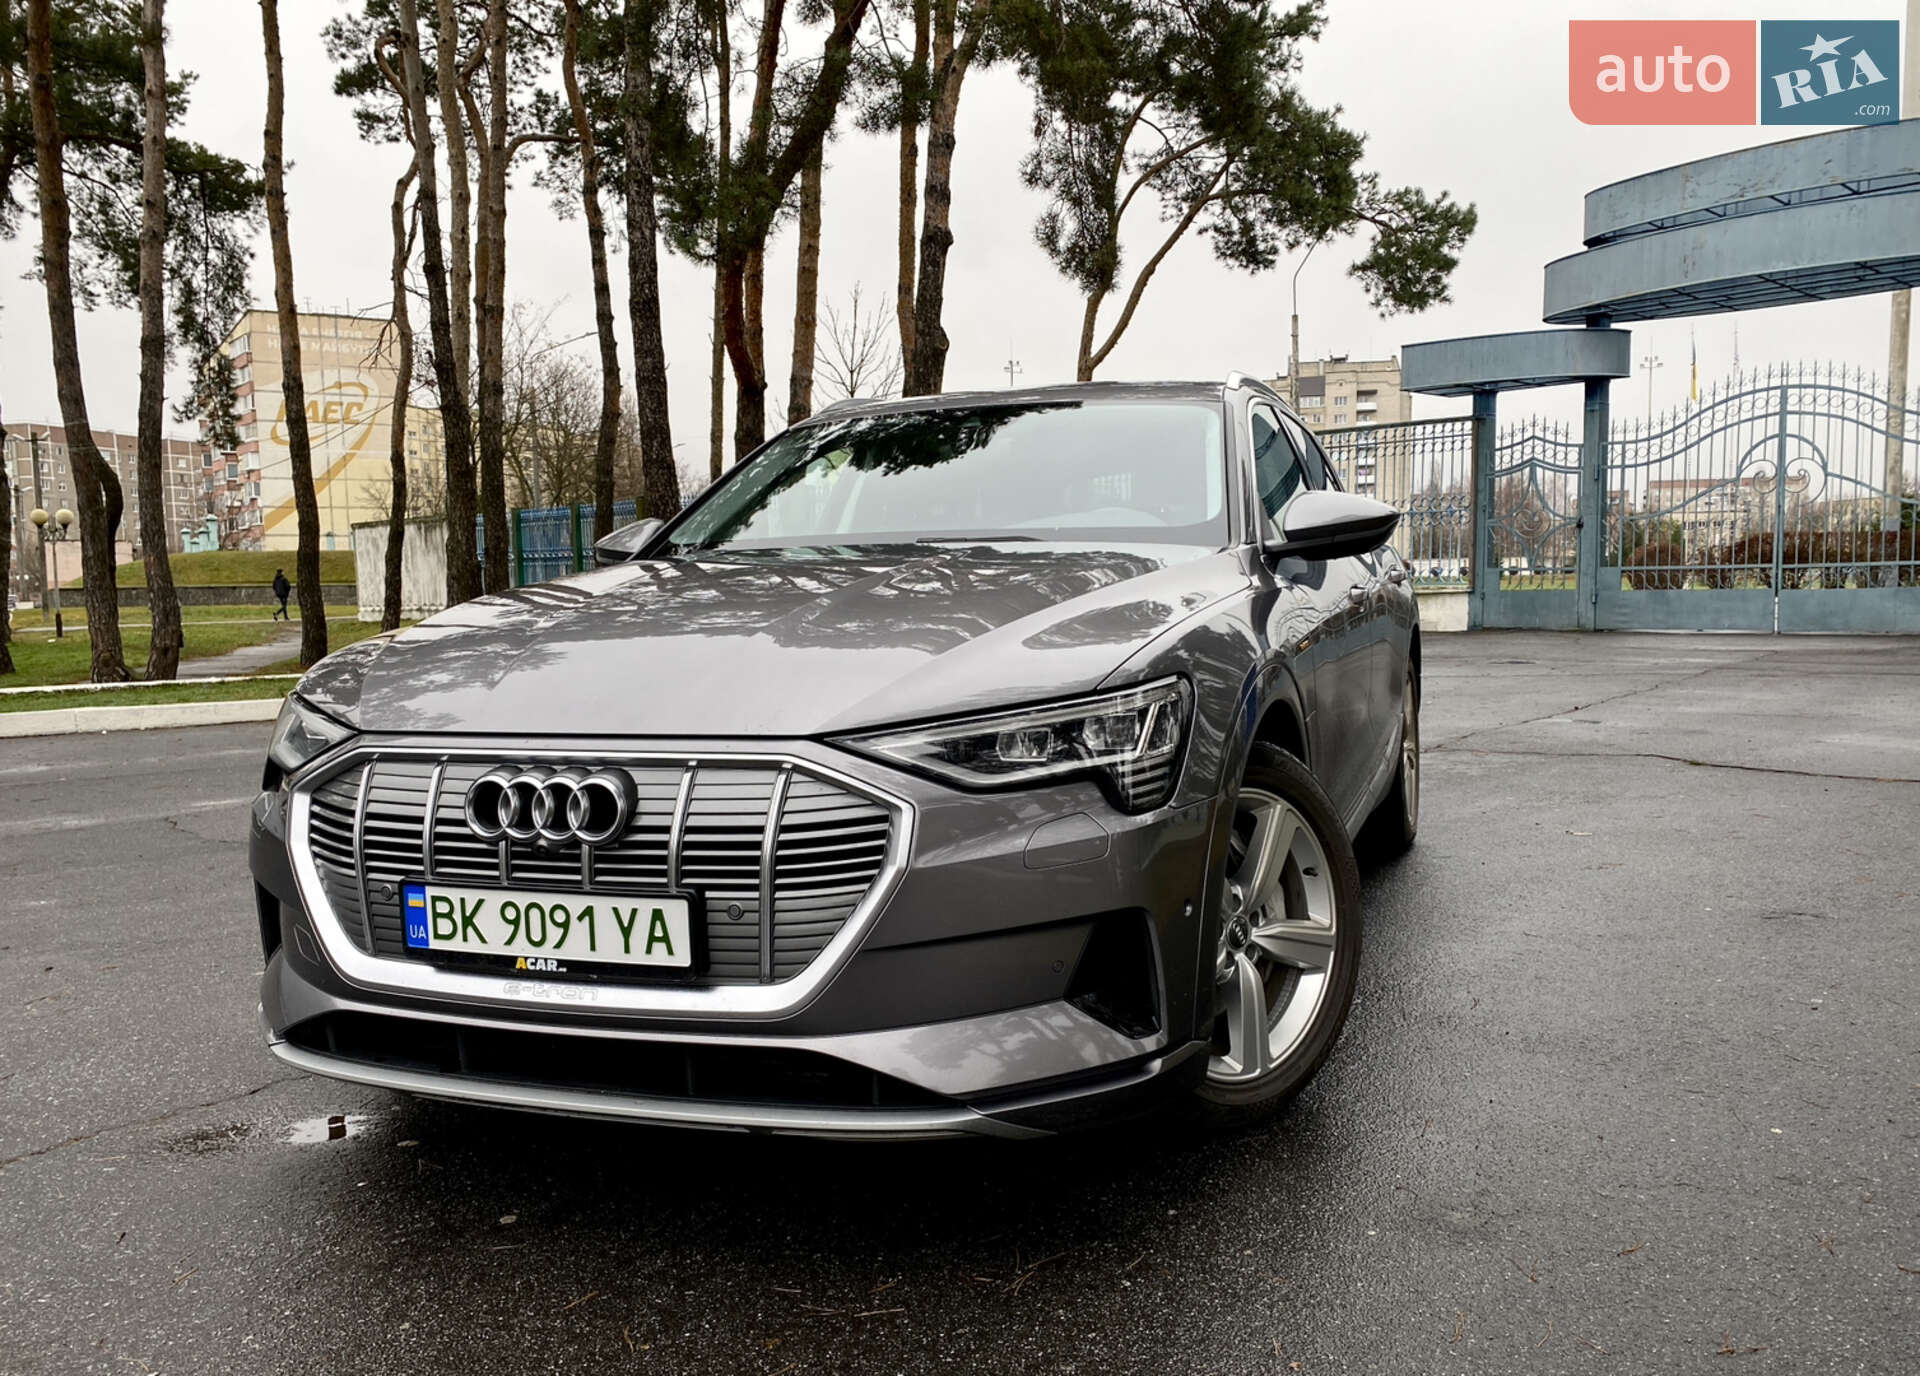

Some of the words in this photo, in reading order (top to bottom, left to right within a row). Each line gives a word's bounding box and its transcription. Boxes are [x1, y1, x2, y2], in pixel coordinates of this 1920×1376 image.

[409, 924, 427, 940] UA
[431, 895, 488, 944] BK
[500, 901, 596, 952] 9091
[612, 906, 675, 956] YA
[503, 982, 598, 1001] e-tron
